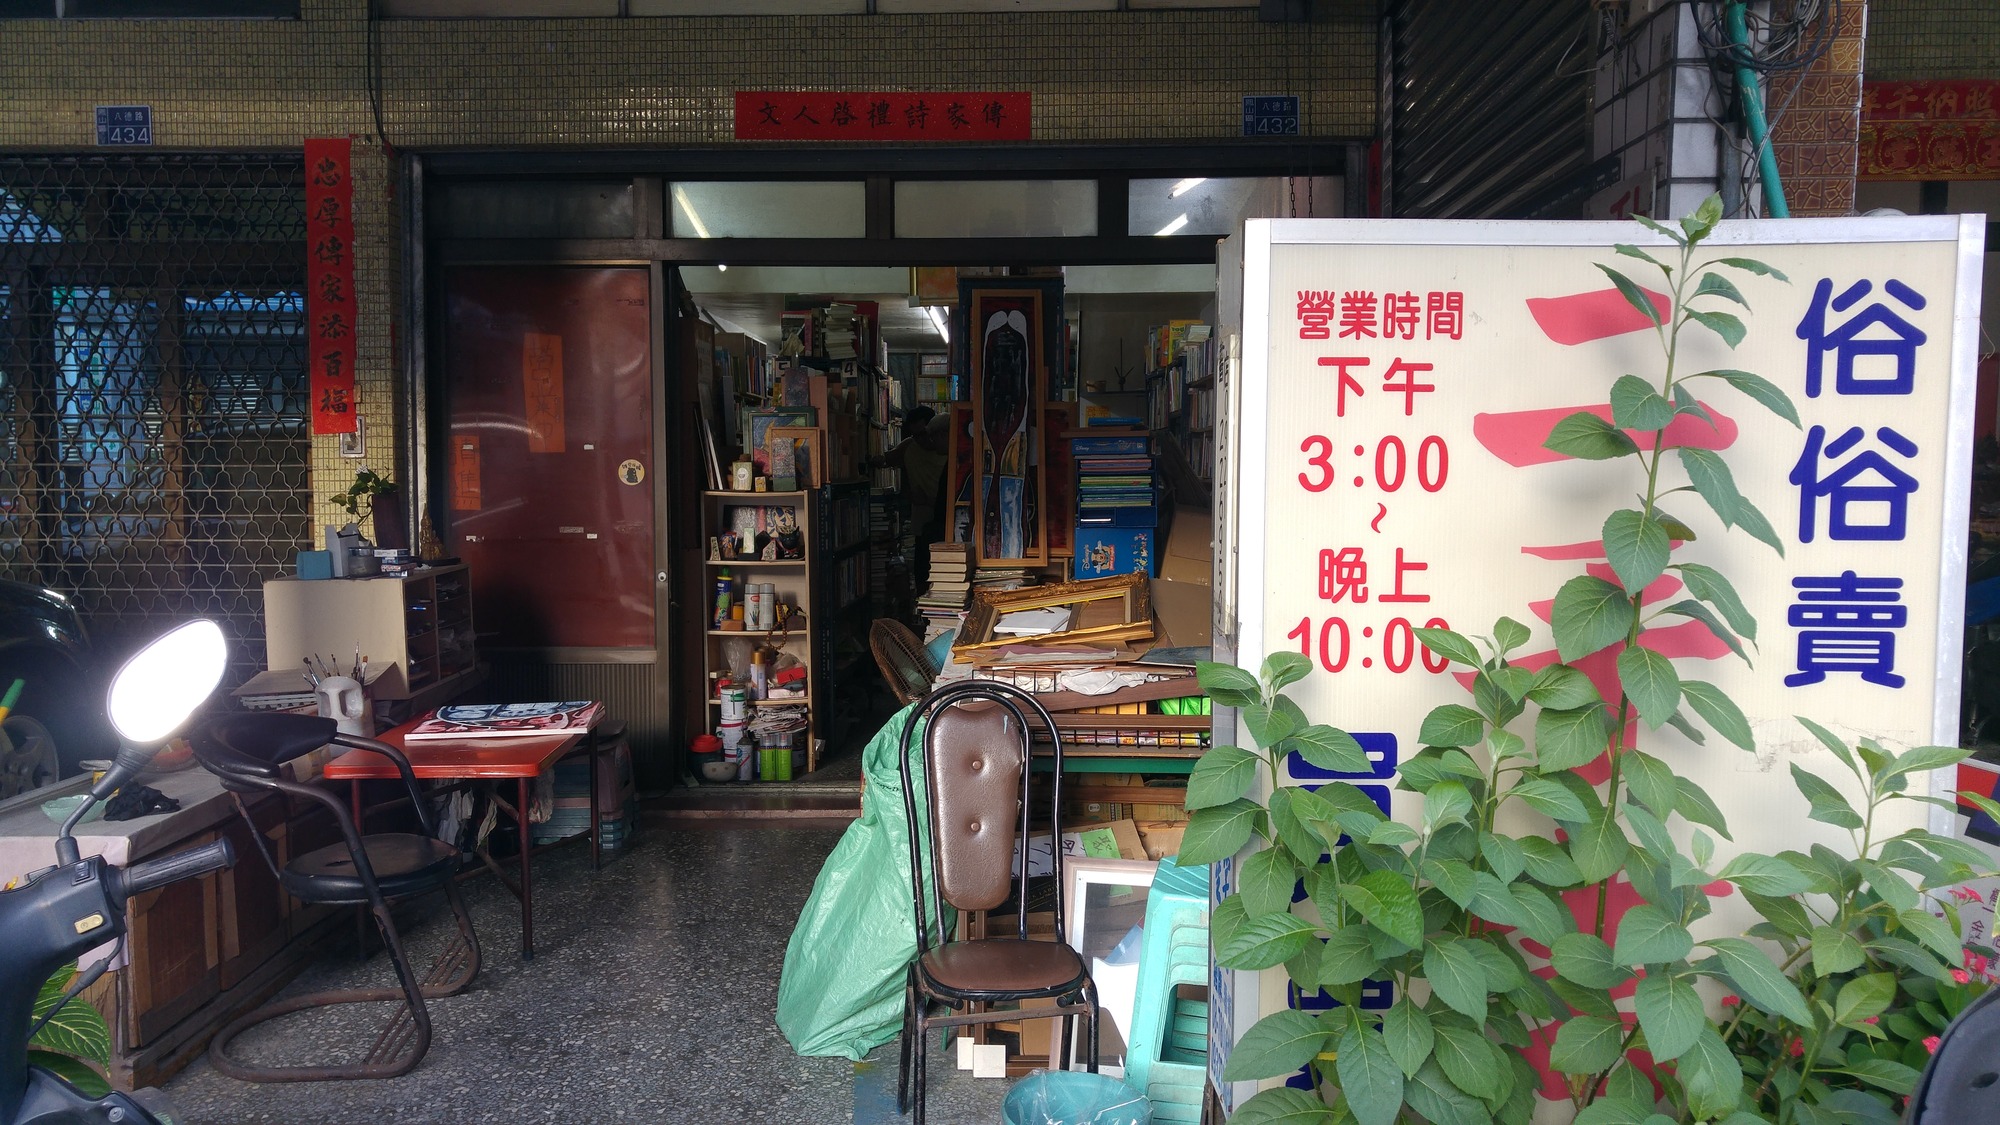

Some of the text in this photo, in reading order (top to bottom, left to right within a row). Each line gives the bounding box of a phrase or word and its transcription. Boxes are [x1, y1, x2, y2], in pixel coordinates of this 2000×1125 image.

[114, 111, 143, 121] 八德路
[1257, 117, 1297, 134] 432
[1262, 101, 1292, 112] 八德路
[110, 127, 149, 143] 434
[313, 156, 349, 415] 忠厚傳家添百福
[1296, 290, 1464, 341] 營業時間
[844, 361, 854, 376] 4
[1317, 356, 1436, 418] 下午
[1297, 434, 1450, 493] 3:00
[1784, 277, 1928, 690] 俗俗賣
[1318, 547, 1431, 604] 晚上
[1287, 616, 1453, 675] 10:00
